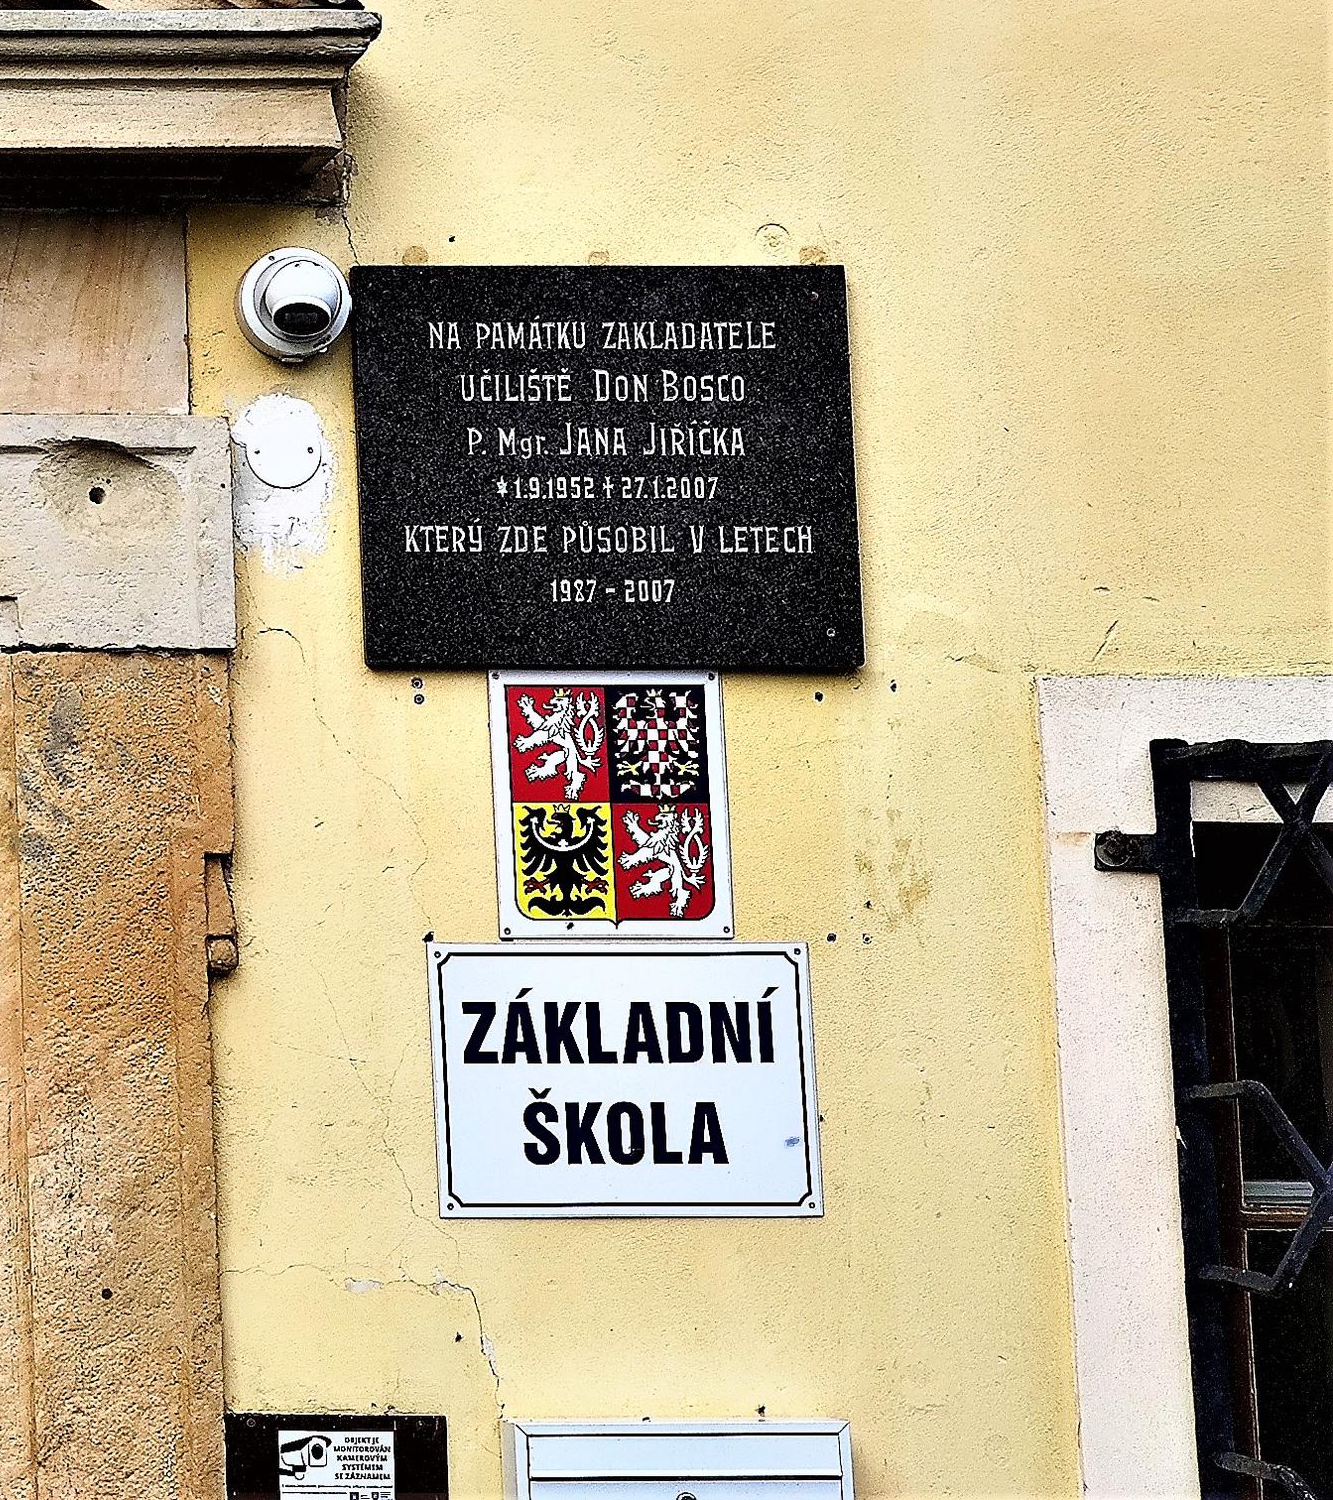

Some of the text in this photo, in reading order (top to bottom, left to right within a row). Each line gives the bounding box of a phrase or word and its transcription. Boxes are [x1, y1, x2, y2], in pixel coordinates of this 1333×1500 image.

[428, 315, 777, 350] NA PAMÁTKU ZAKLADATELE
[460, 367, 572, 402] UČILIŠTĚ
[466, 419, 746, 459] P. Mgr. JANA JIŘÍČKA
[404, 518, 814, 554] KTERÝ ZDE PŮSOBIL V LETECH
[550, 578, 597, 603] 1987
[624, 578, 675, 603] 2007
[461, 986, 780, 1064] ZÁKLADNÍ
[522, 1087, 731, 1166] ŠKOLA
[333, 1444, 391, 1453] MONITOROVÁN
[336, 1453, 388, 1462] KAMEROVÝM
[344, 1436, 370, 1445] OBJEKT
[341, 1462, 384, 1471] SYSTÉMEM
